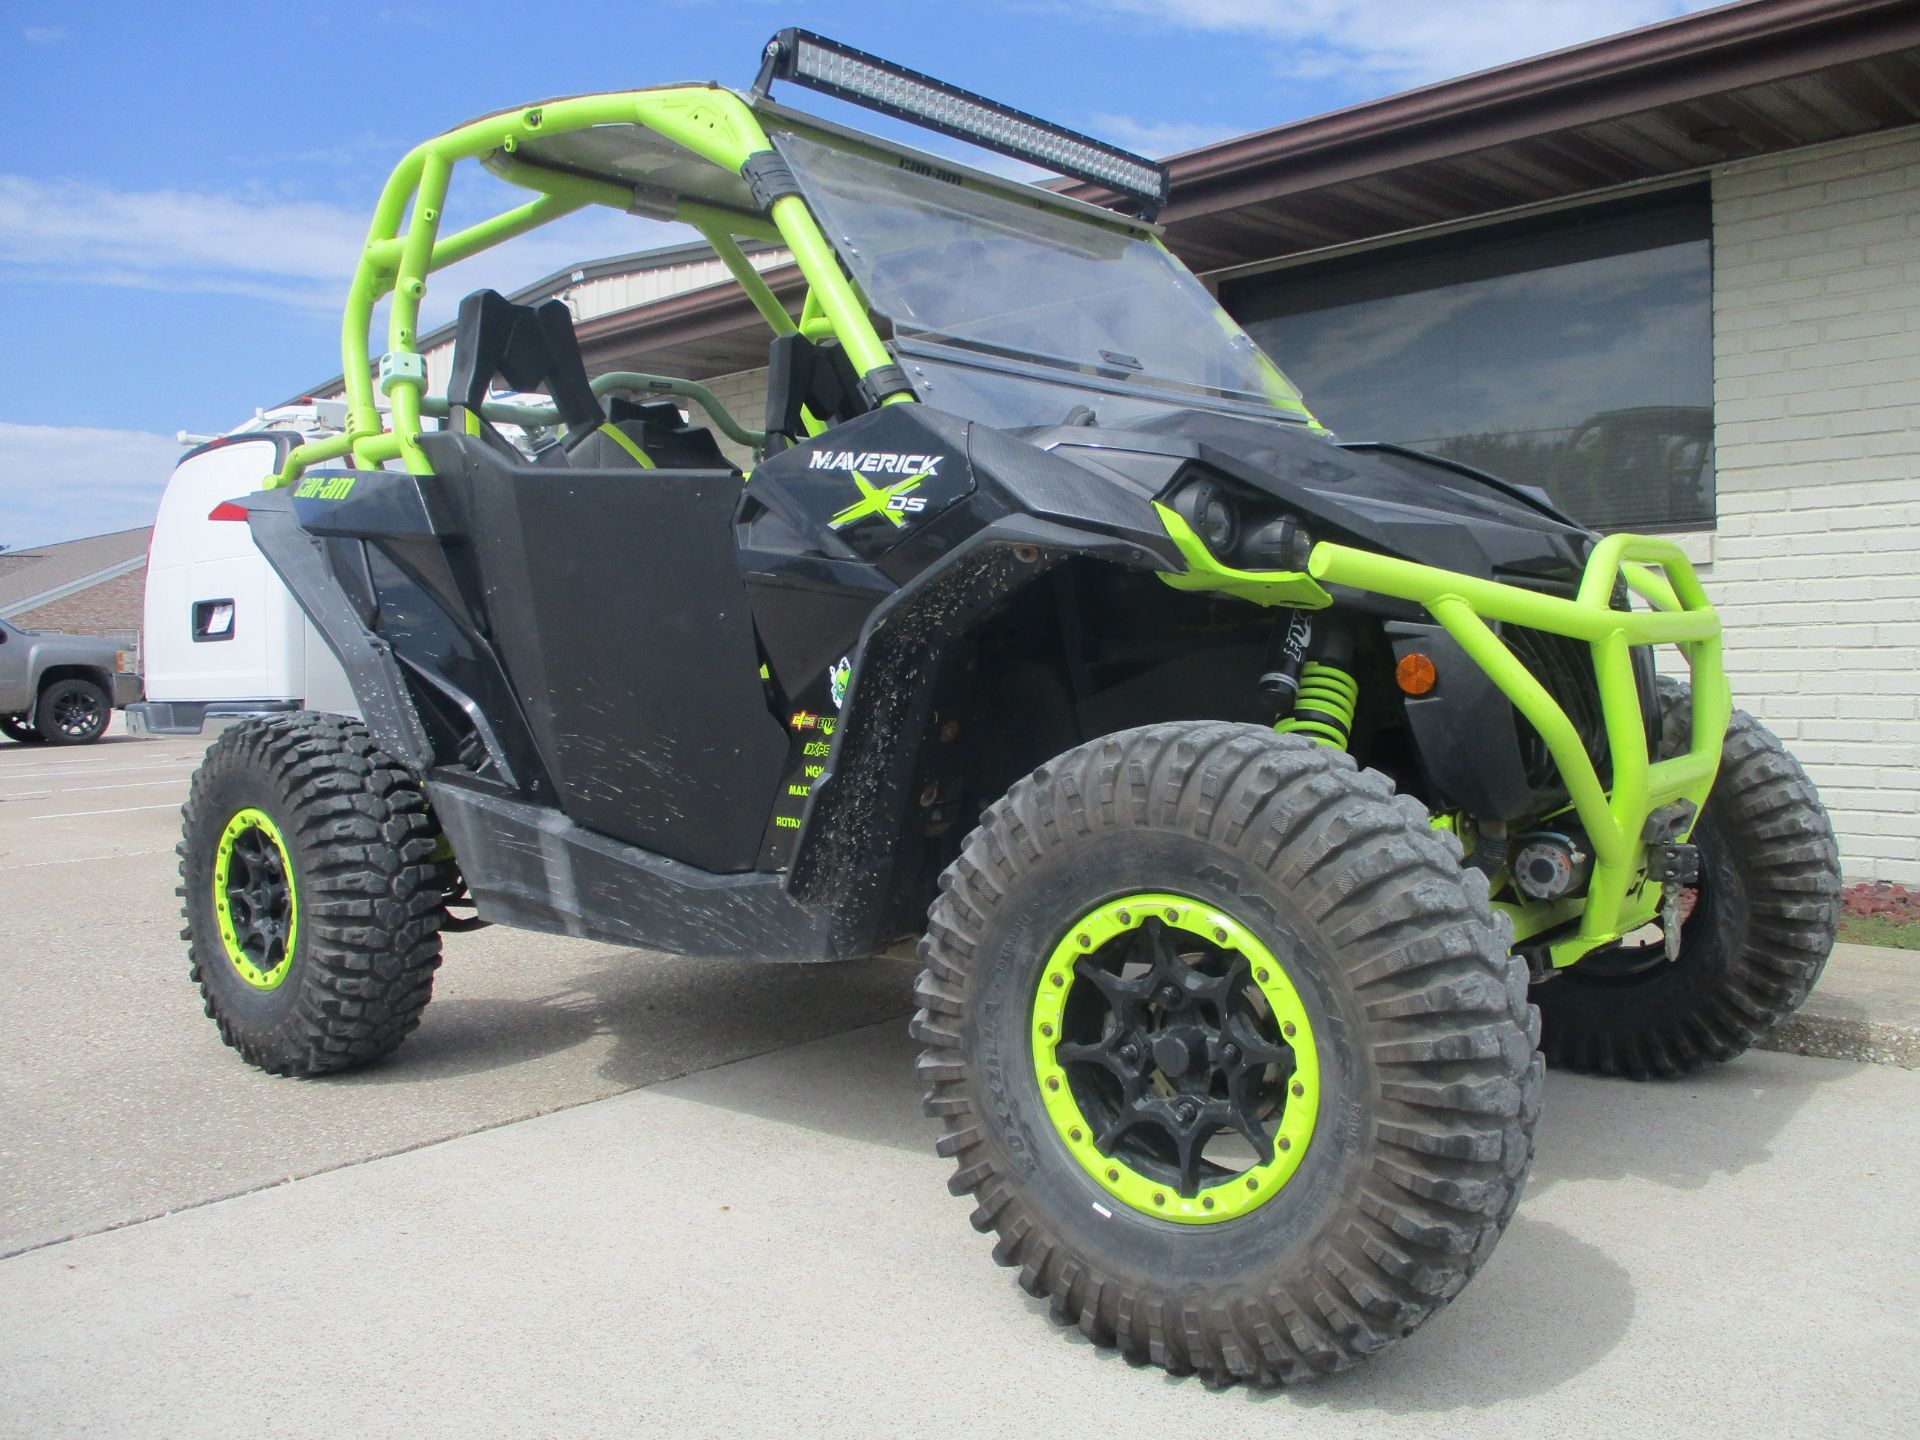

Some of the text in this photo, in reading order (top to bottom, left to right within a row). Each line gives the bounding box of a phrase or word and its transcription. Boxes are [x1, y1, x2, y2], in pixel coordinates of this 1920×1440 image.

[808, 450, 945, 476] MAVERICK
[293, 477, 356, 500] can-am
[886, 495, 928, 512] DS
